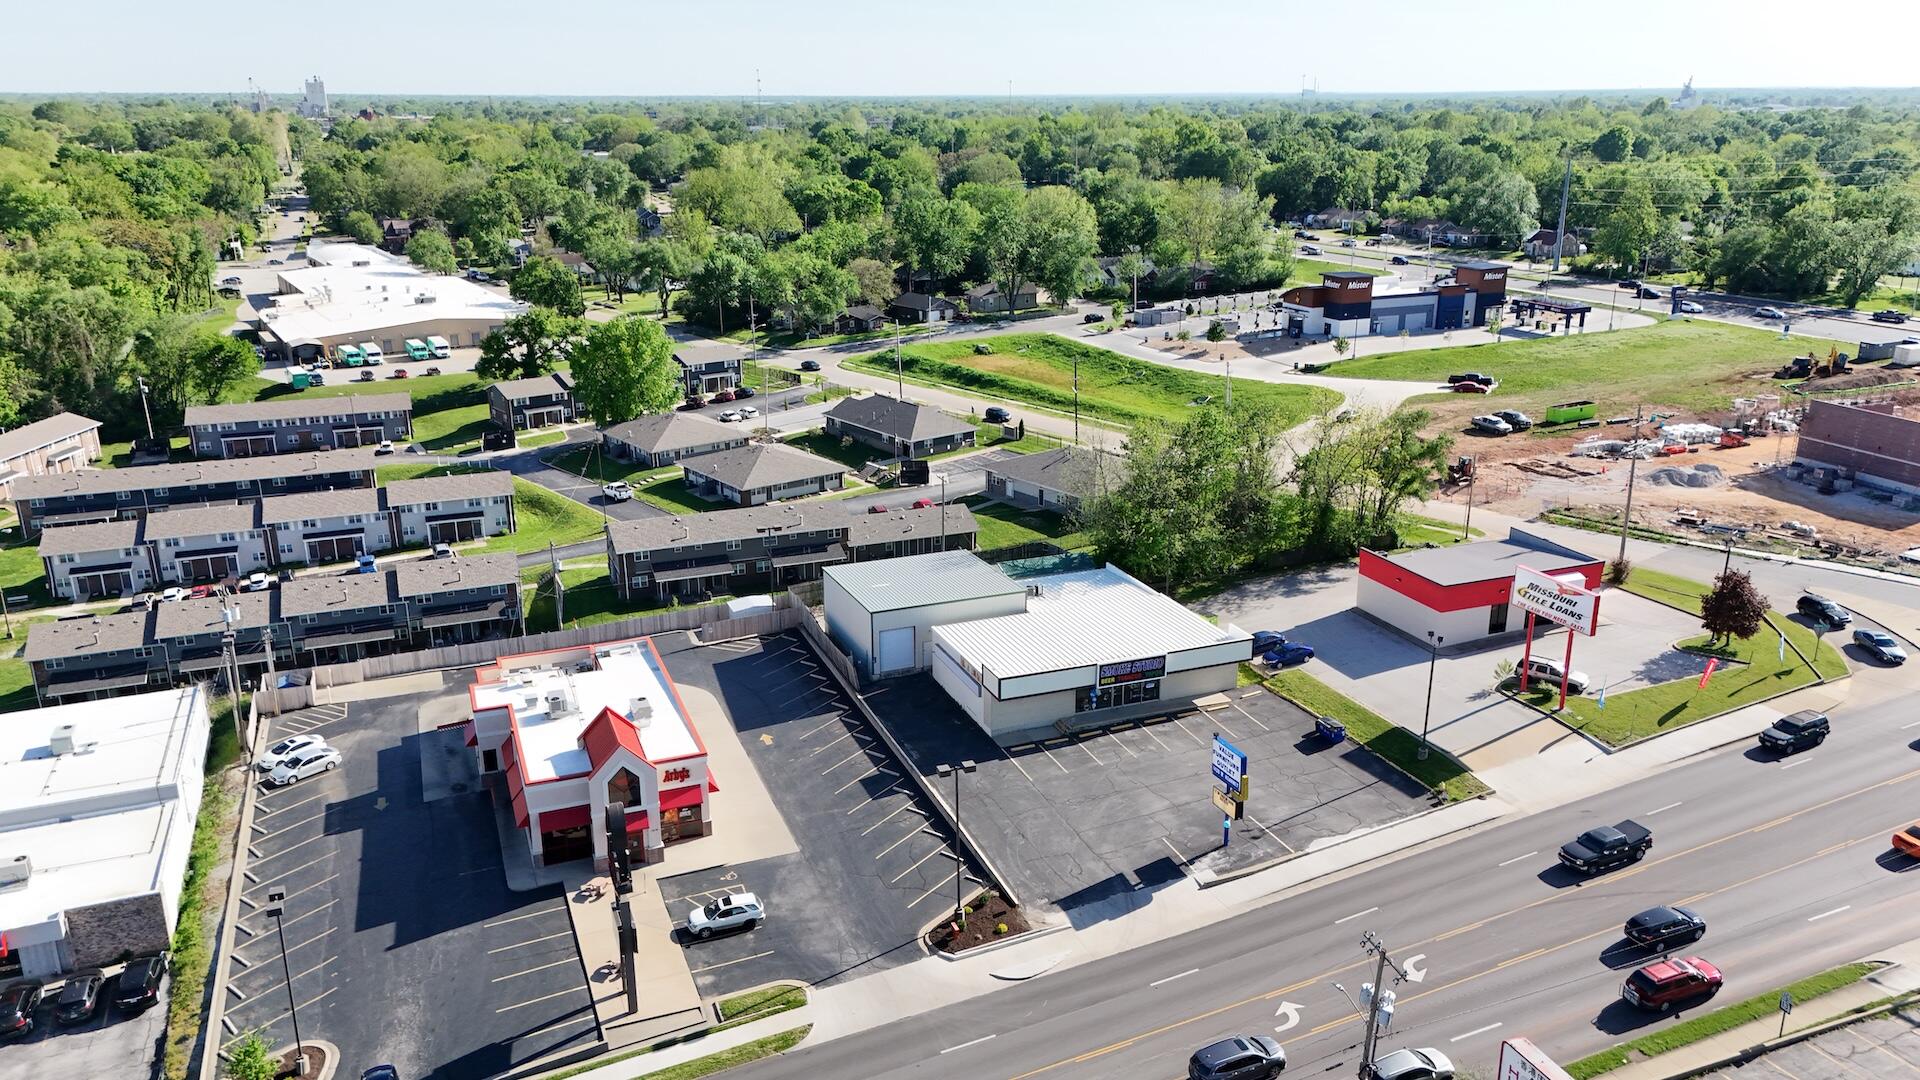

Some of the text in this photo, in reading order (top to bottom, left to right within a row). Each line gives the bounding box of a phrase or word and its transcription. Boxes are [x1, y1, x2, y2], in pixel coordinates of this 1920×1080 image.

[1483, 272, 1504, 281] Mister
[1324, 280, 1341, 289] Mister
[1347, 281, 1370, 290] Mister
[1527, 582, 1578, 608] MISSOURI
[1521, 590, 1584, 621] TITLE LOANS
[1526, 604, 1541, 614] CASH
[1541, 610, 1553, 619] YOU
[1101, 663, 1132, 678] SMOKE
[1101, 676, 1115, 685] BEER
[1219, 745, 1234, 760] VALUE
[1213, 749, 1239, 772] FURNITURE
[1217, 760, 1235, 776] OUTLET
[663, 767, 690, 783] Arby's
